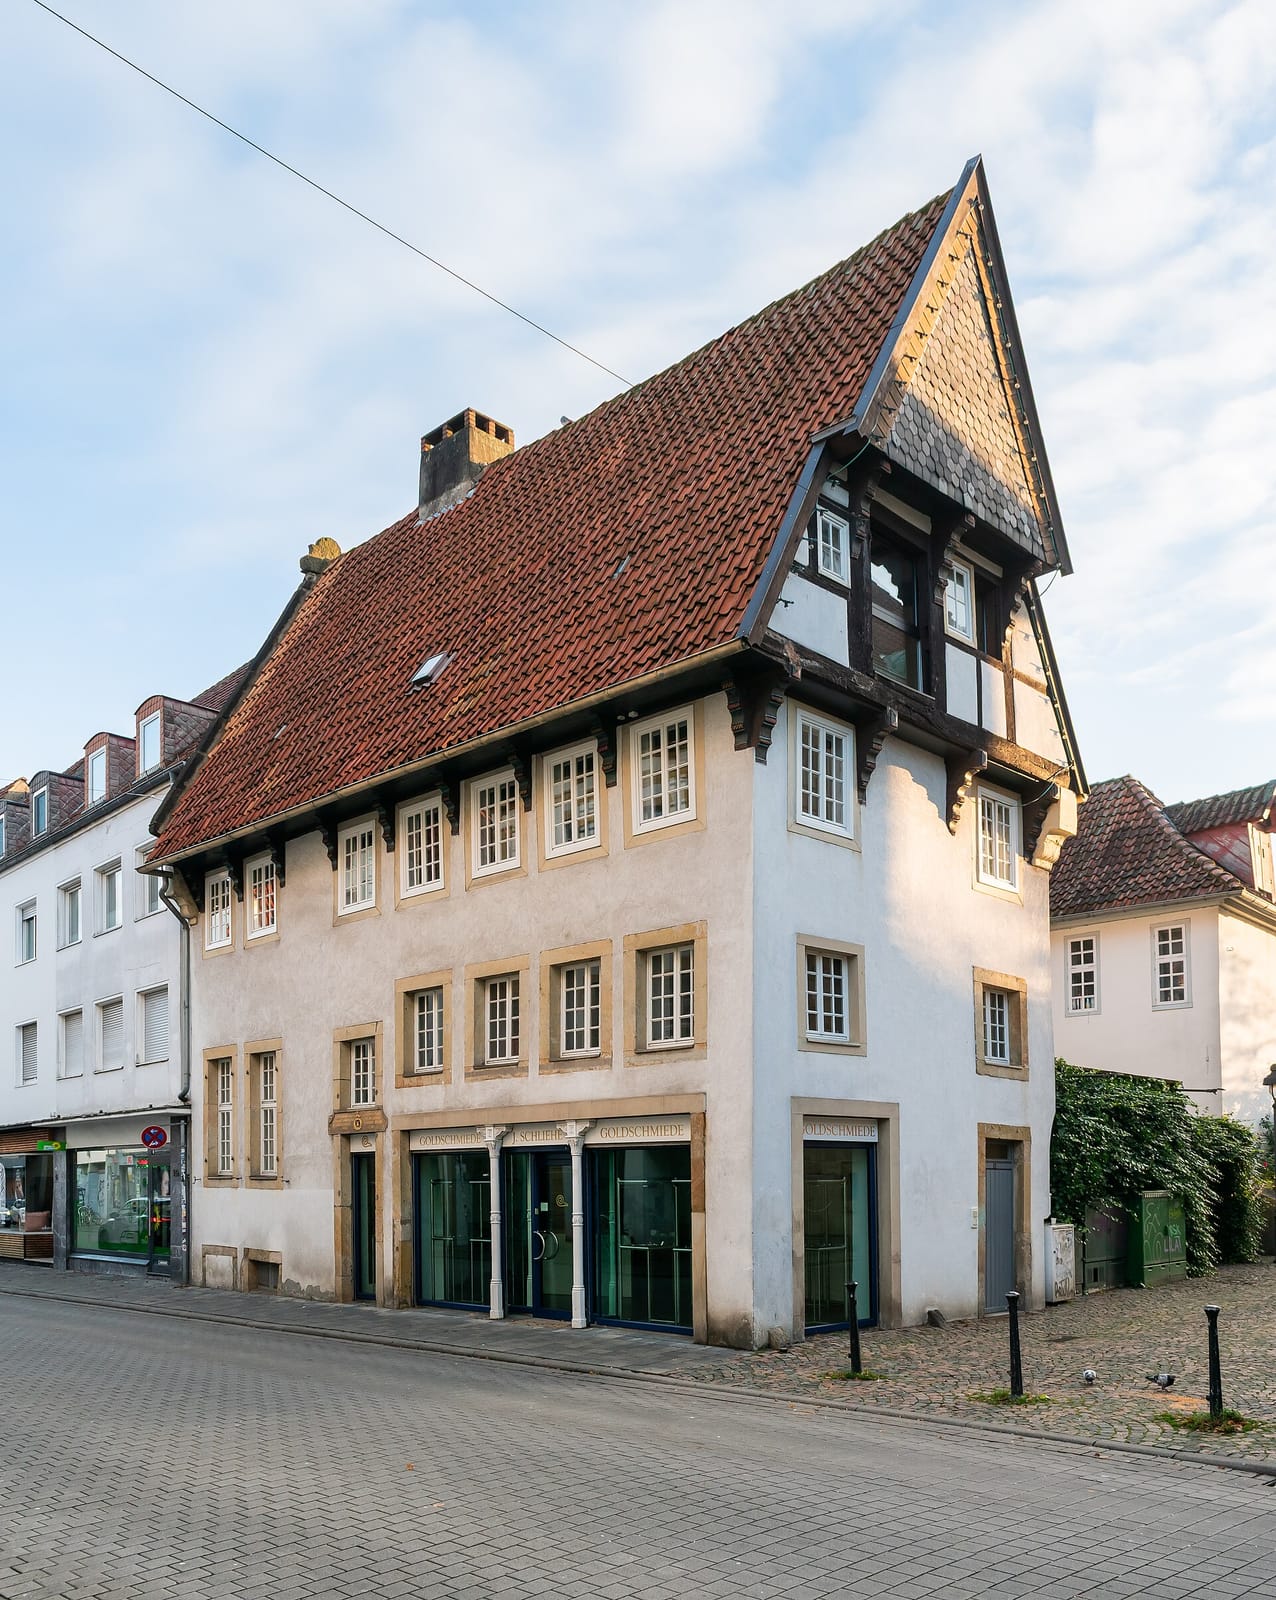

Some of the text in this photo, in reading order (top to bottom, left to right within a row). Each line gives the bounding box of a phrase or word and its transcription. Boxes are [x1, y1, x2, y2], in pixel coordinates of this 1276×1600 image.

[600, 1124, 685, 1139] GOLDSCHMIEDE
[419, 1133, 481, 1146] GOLDSCHMIEDE
[511, 1132, 518, 1145] J.
